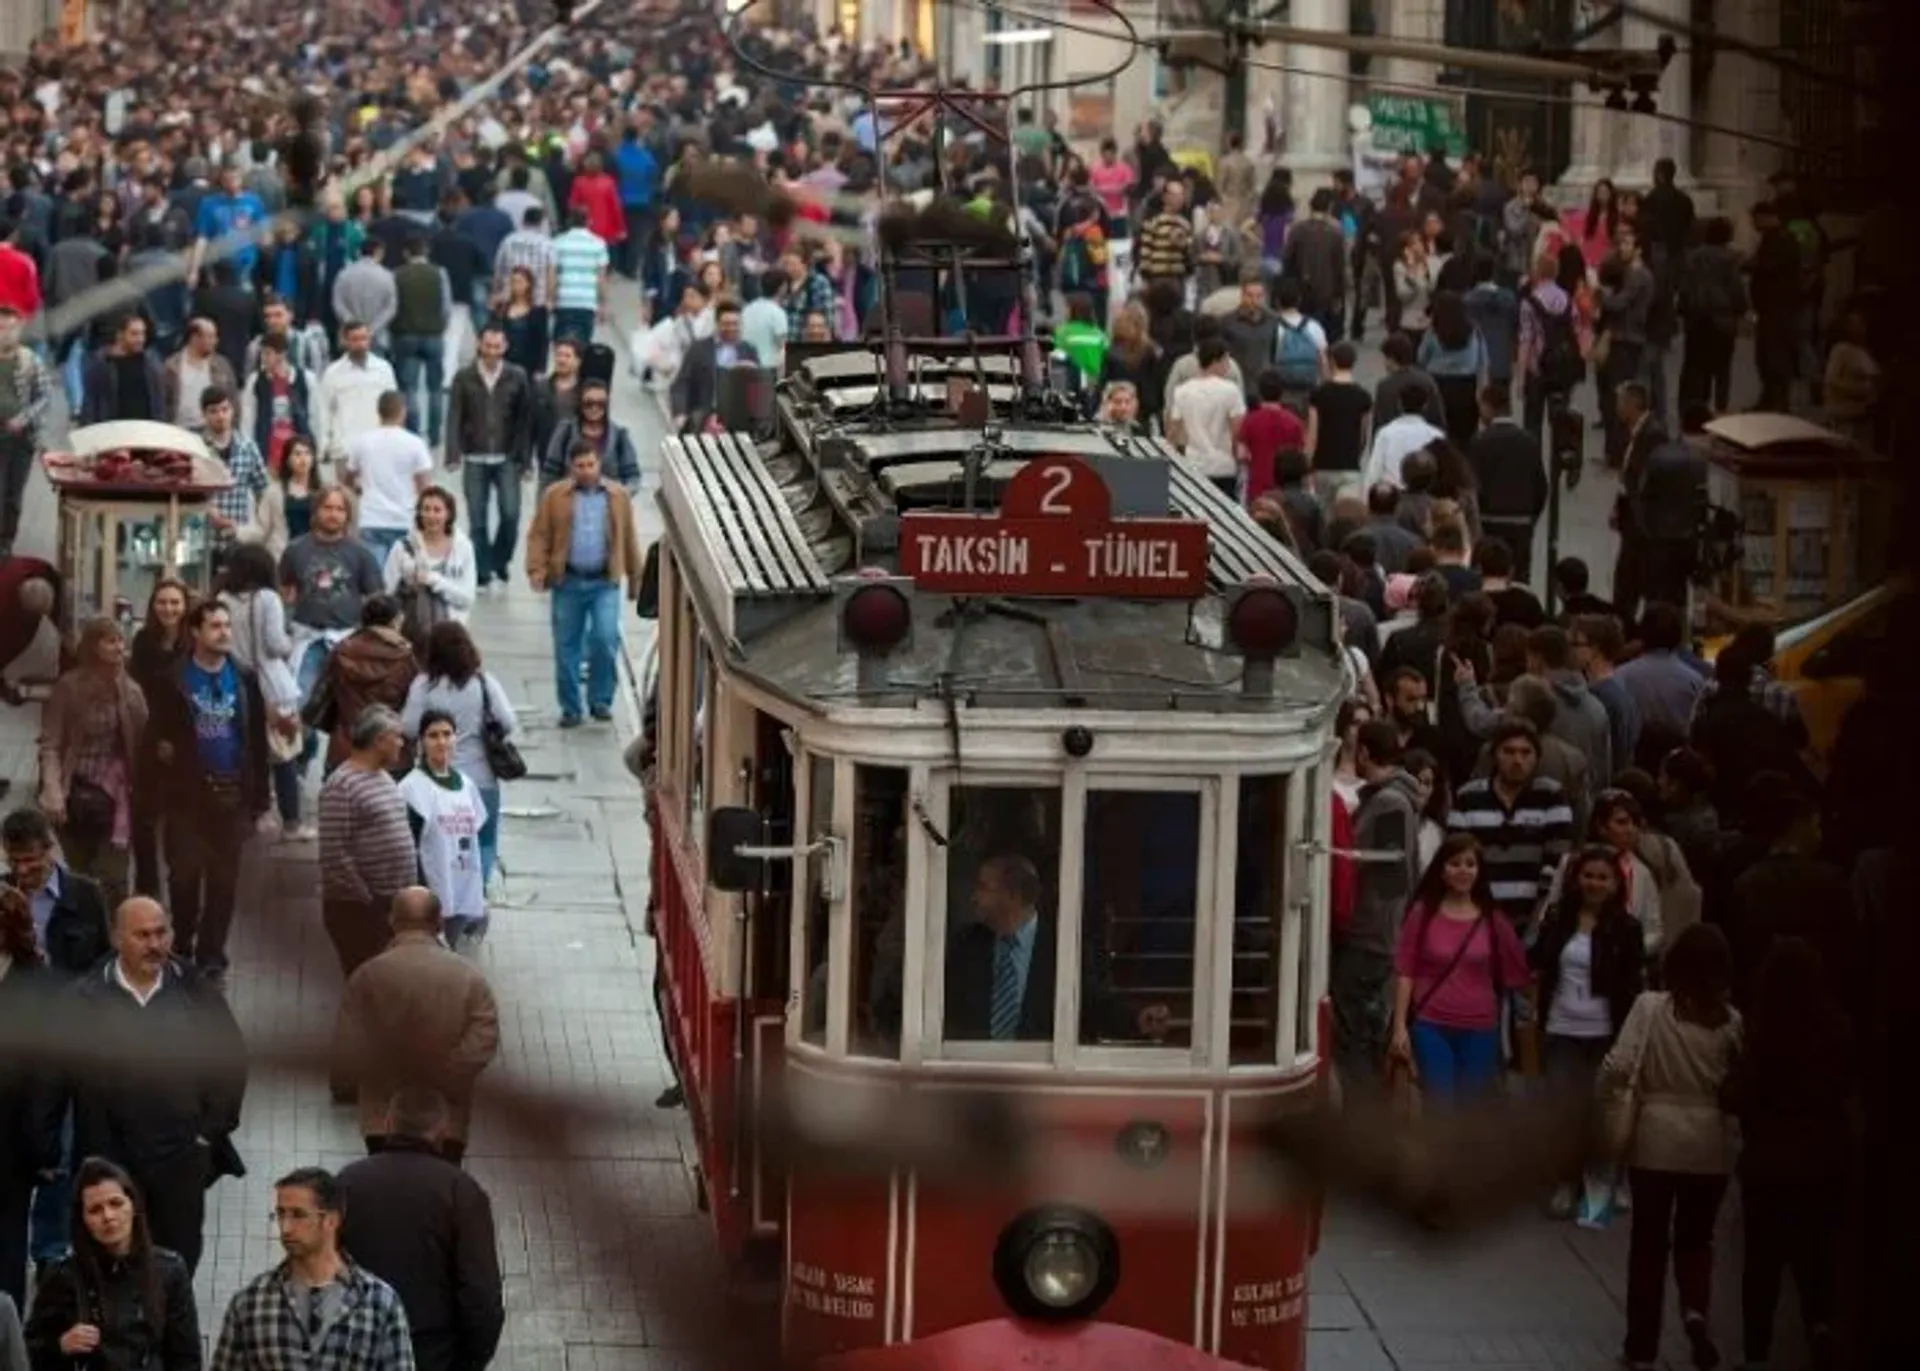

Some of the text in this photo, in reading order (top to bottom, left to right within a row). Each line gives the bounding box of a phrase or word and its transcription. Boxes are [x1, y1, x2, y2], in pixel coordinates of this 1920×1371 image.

[1041, 465, 1072, 514] 2
[916, 529, 1028, 575] TAKSİM
[1083, 532, 1189, 578] TÜNEL
